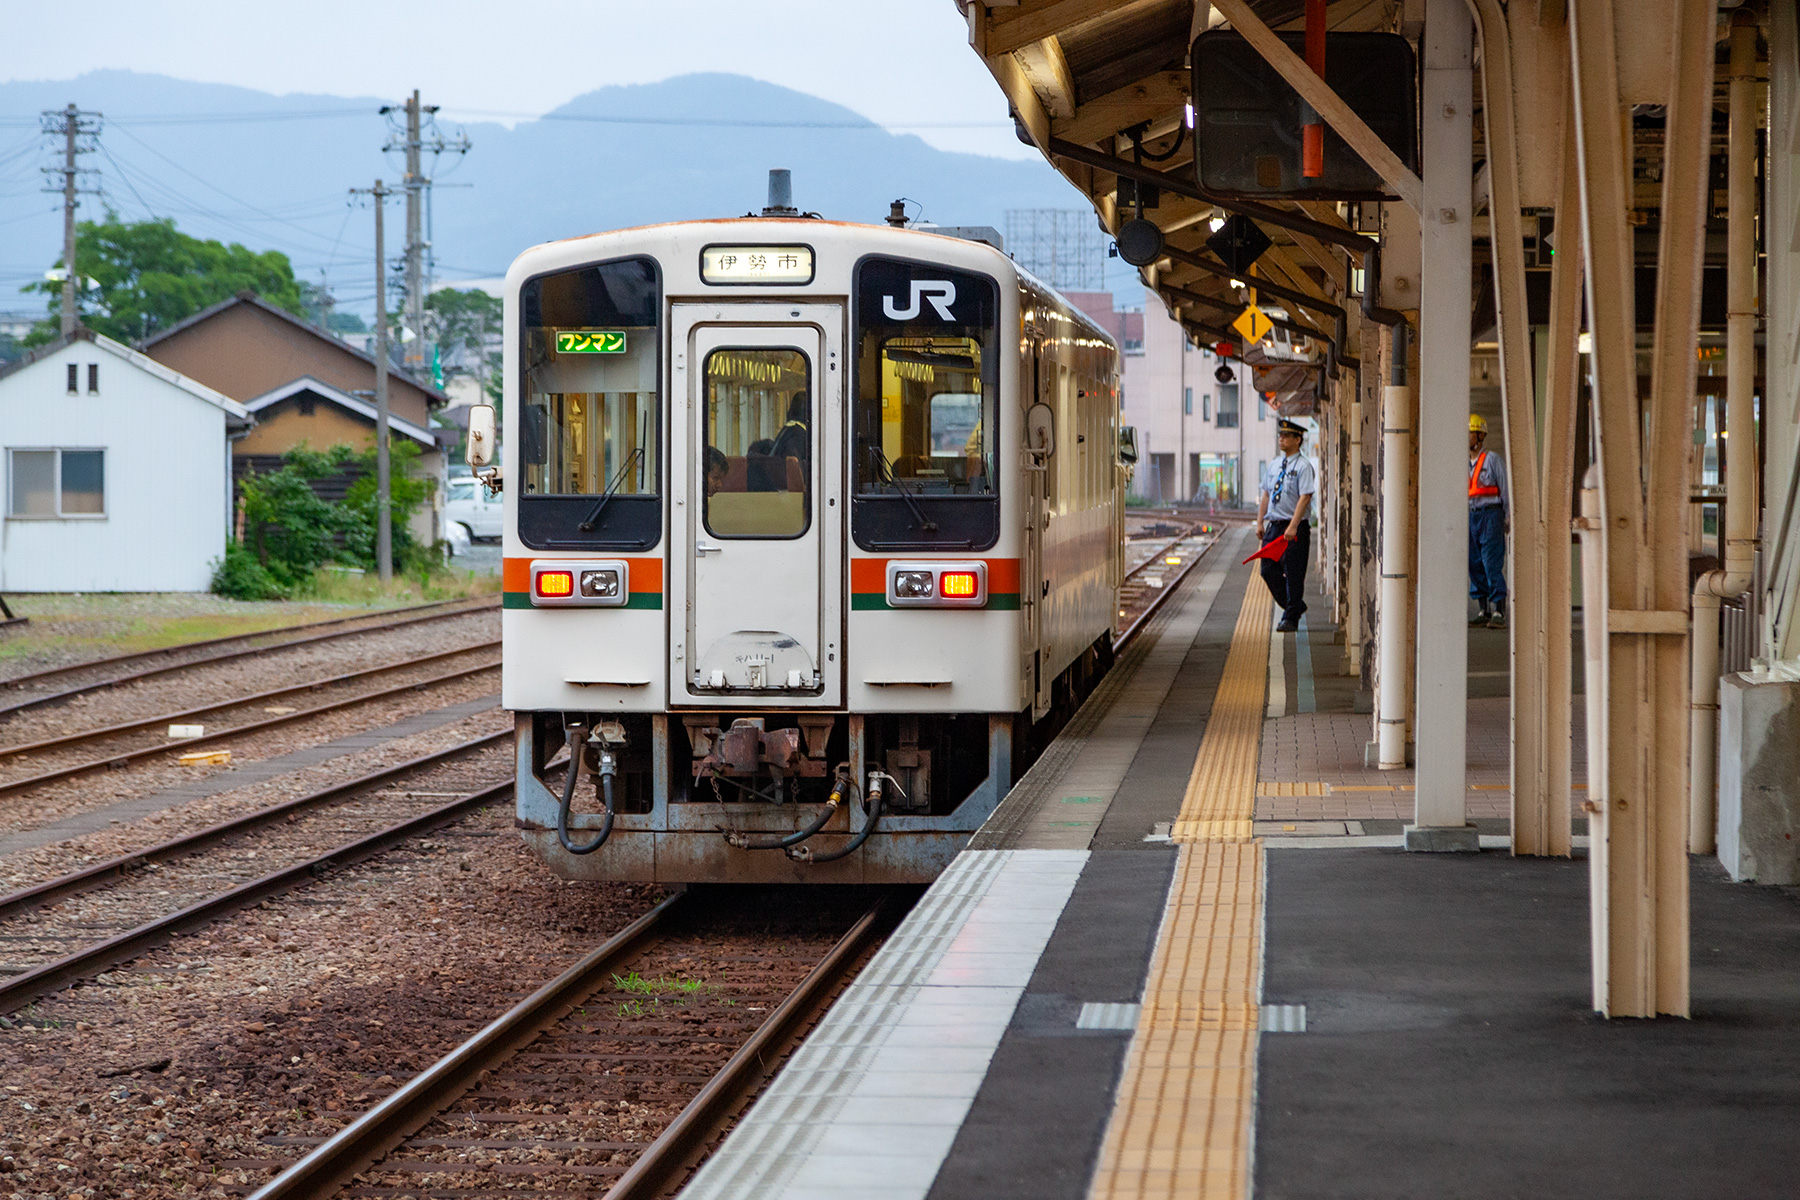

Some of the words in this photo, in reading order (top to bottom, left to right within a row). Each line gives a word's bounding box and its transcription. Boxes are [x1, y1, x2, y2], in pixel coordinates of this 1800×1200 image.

[718, 254, 798, 270] 伊勢市
[883, 280, 956, 321] JR
[1250, 312, 1256, 337] 1
[559, 334, 623, 351] ワンマン
